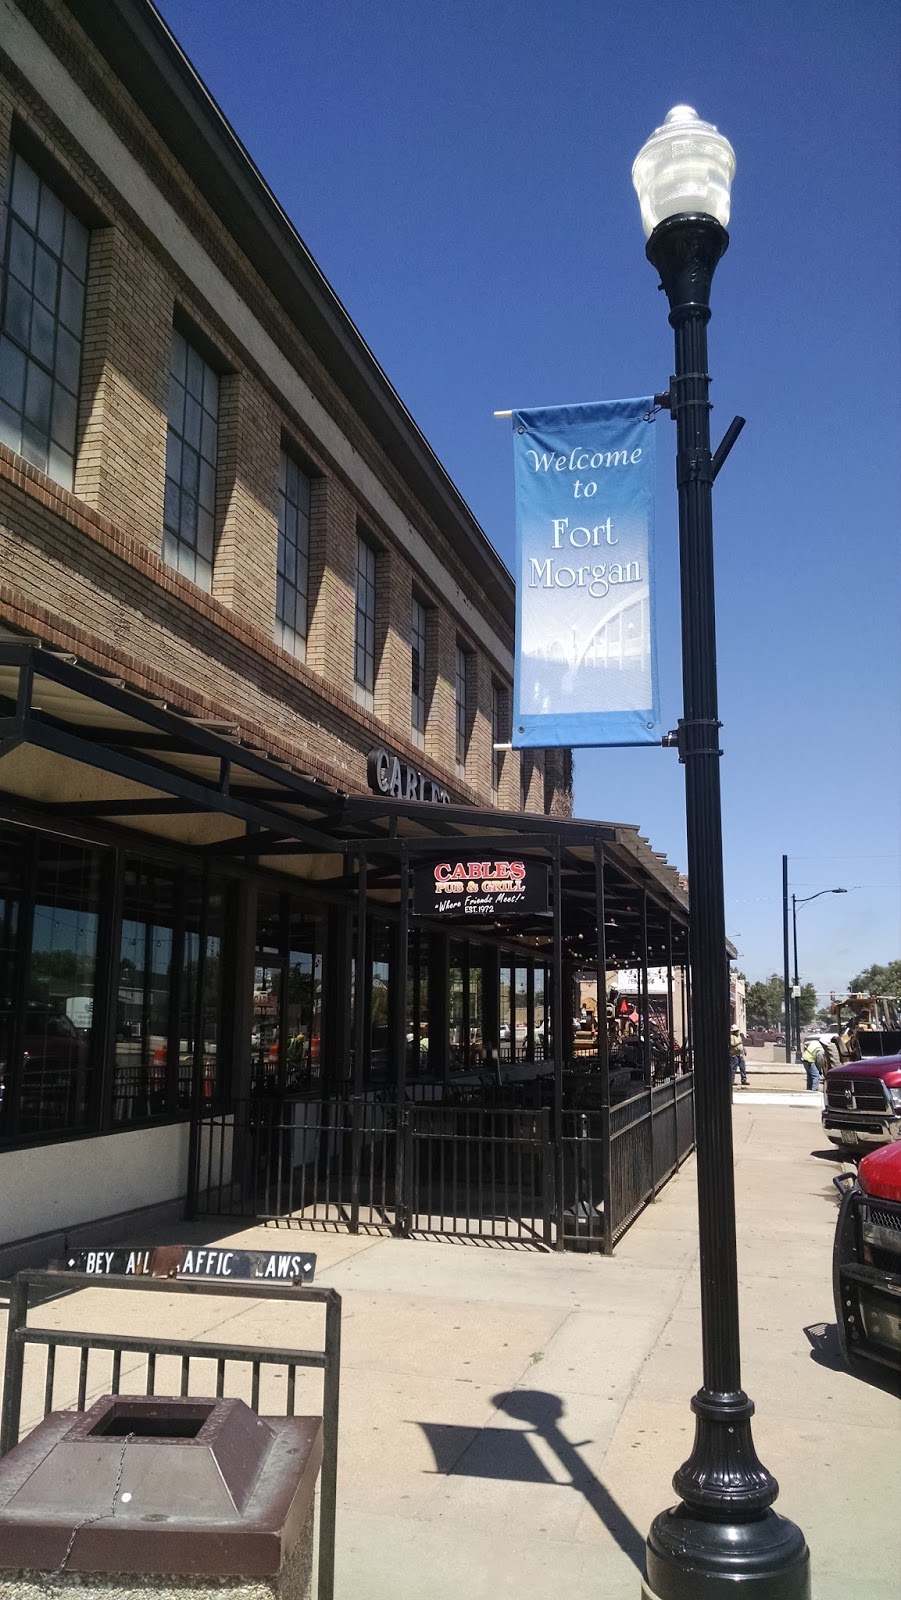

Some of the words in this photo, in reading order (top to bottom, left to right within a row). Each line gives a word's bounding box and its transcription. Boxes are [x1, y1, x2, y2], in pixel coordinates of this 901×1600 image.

[525, 446, 642, 472] Welcome
[573, 479, 597, 498] to
[551, 517, 619, 549] Fort
[528, 558, 642, 598] Morgan
[434, 861, 526, 882] CABLES
[435, 882, 464, 893] PUB
[466, 881, 478, 893] &
[481, 880, 526, 893] GRILL
[465, 894, 493, 906] Friends
[81, 1252, 115, 1274] BEY
